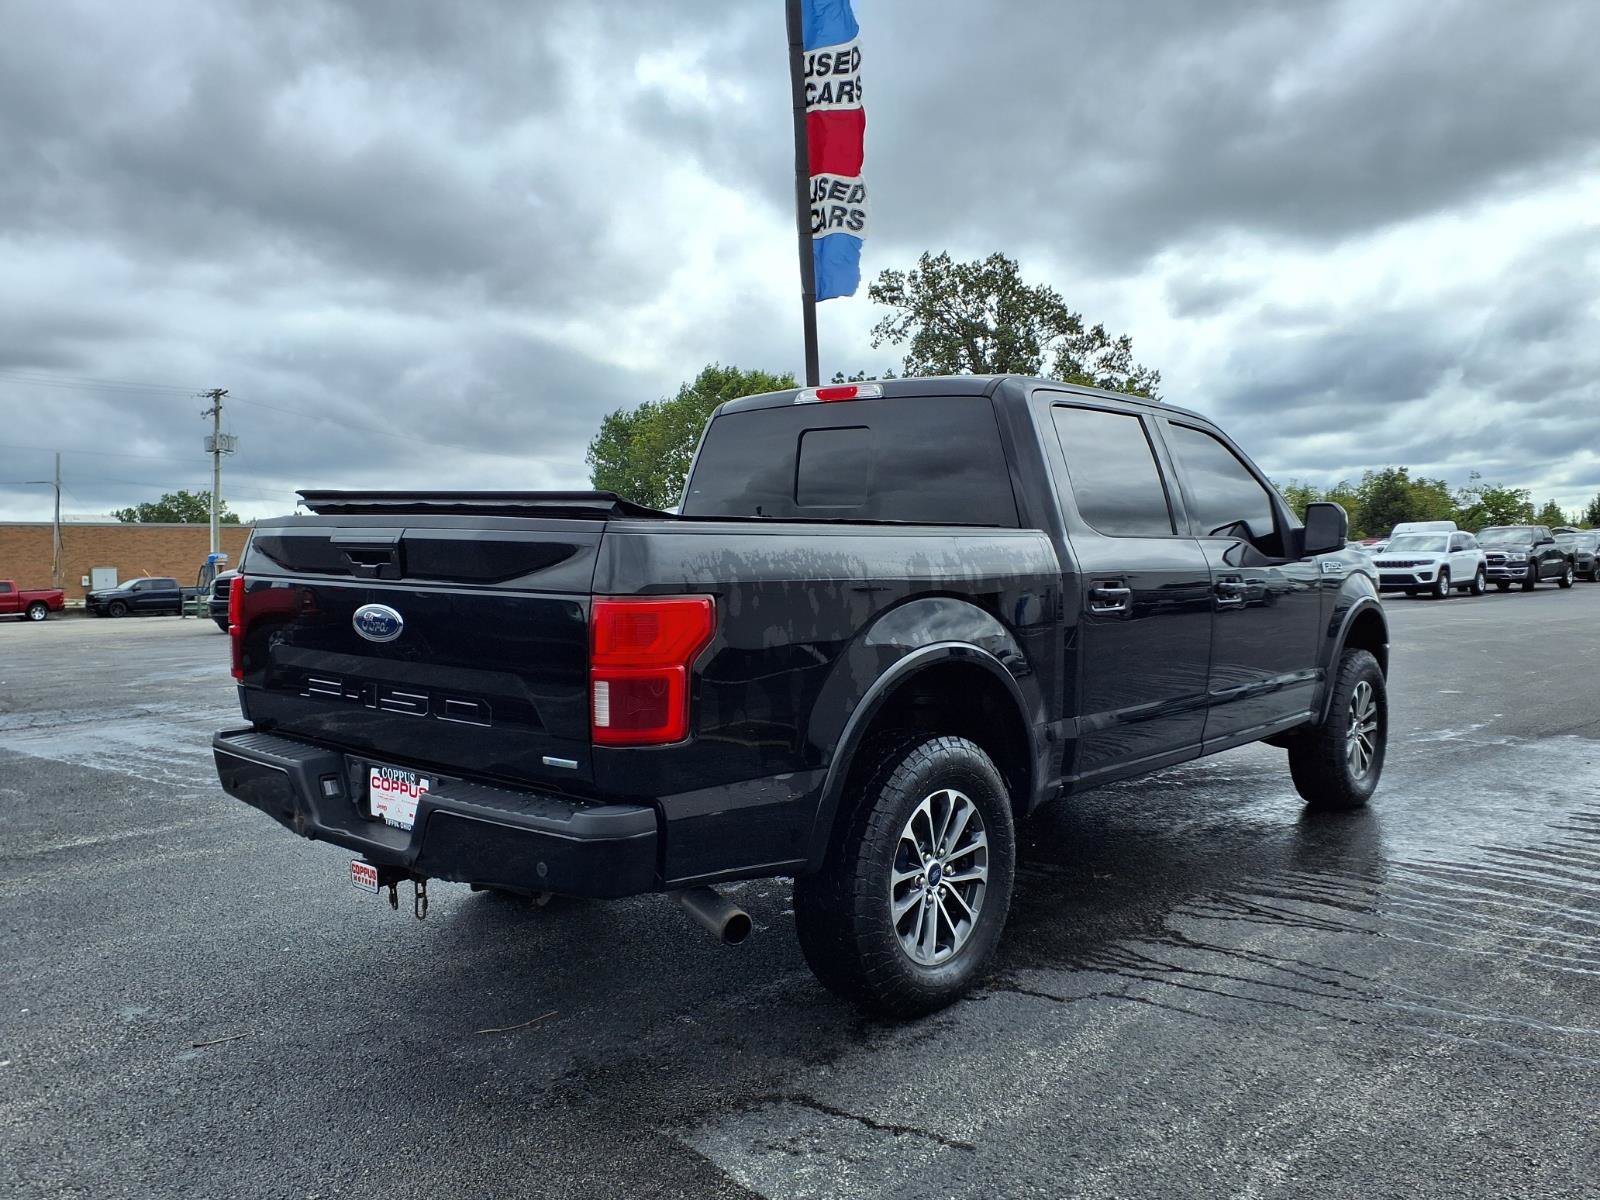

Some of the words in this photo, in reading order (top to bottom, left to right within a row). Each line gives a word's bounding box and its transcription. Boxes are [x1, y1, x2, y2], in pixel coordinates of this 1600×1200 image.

[803, 46, 861, 77] USED
[805, 75, 862, 107] CARS
[811, 205, 866, 233] CARS
[362, 611, 389, 632] Ford
[300, 674, 492, 728] F-150
[372, 776, 428, 798] COPPUS
[382, 767, 416, 785] COPPUS
[352, 863, 377, 881] COPPUS
